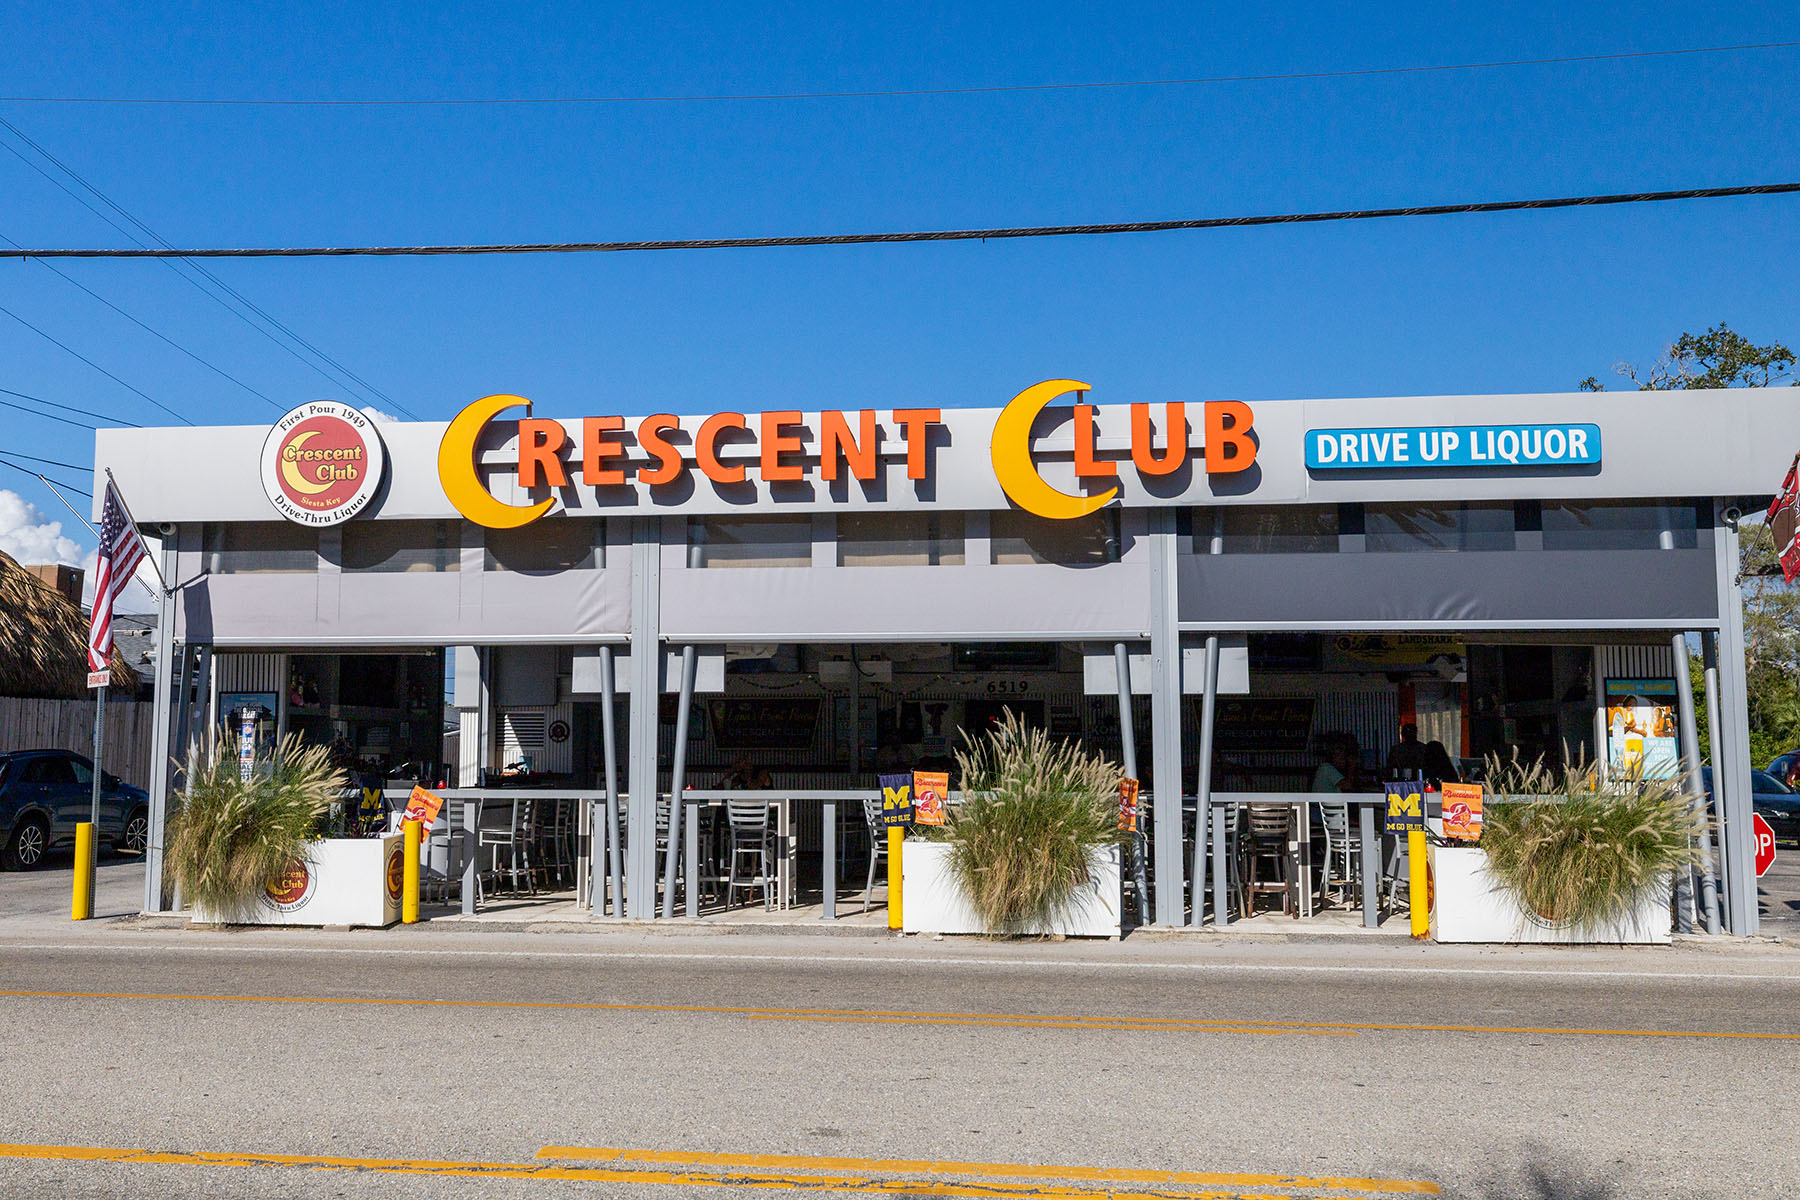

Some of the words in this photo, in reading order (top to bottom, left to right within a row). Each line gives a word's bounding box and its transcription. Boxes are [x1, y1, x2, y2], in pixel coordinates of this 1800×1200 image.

[280, 410, 304, 431] First
[309, 404, 336, 415] Pour
[341, 408, 366, 428] 1949
[282, 445, 362, 462] Crescent
[438, 394, 941, 529] CRESCENT
[991, 378, 1258, 520] CLUB
[1317, 433, 1409, 463] DRIVE
[1418, 431, 1459, 461] UP
[1470, 429, 1589, 463] LIQUOR
[316, 463, 358, 481] Club
[274, 494, 331, 523] Drive-Thru
[334, 493, 367, 520] Liquor
[300, 496, 324, 507] Siesta
[326, 496, 341, 506] Key
[1398, 635, 1454, 645] LANDSHARK
[987, 680, 1028, 693] 6519
[883, 785, 911, 810] M
[1443, 789, 1481, 799] Buccaneers
[1388, 793, 1422, 817] M
[1406, 823, 1423, 832] BLUE
[282, 879, 304, 889] Club
